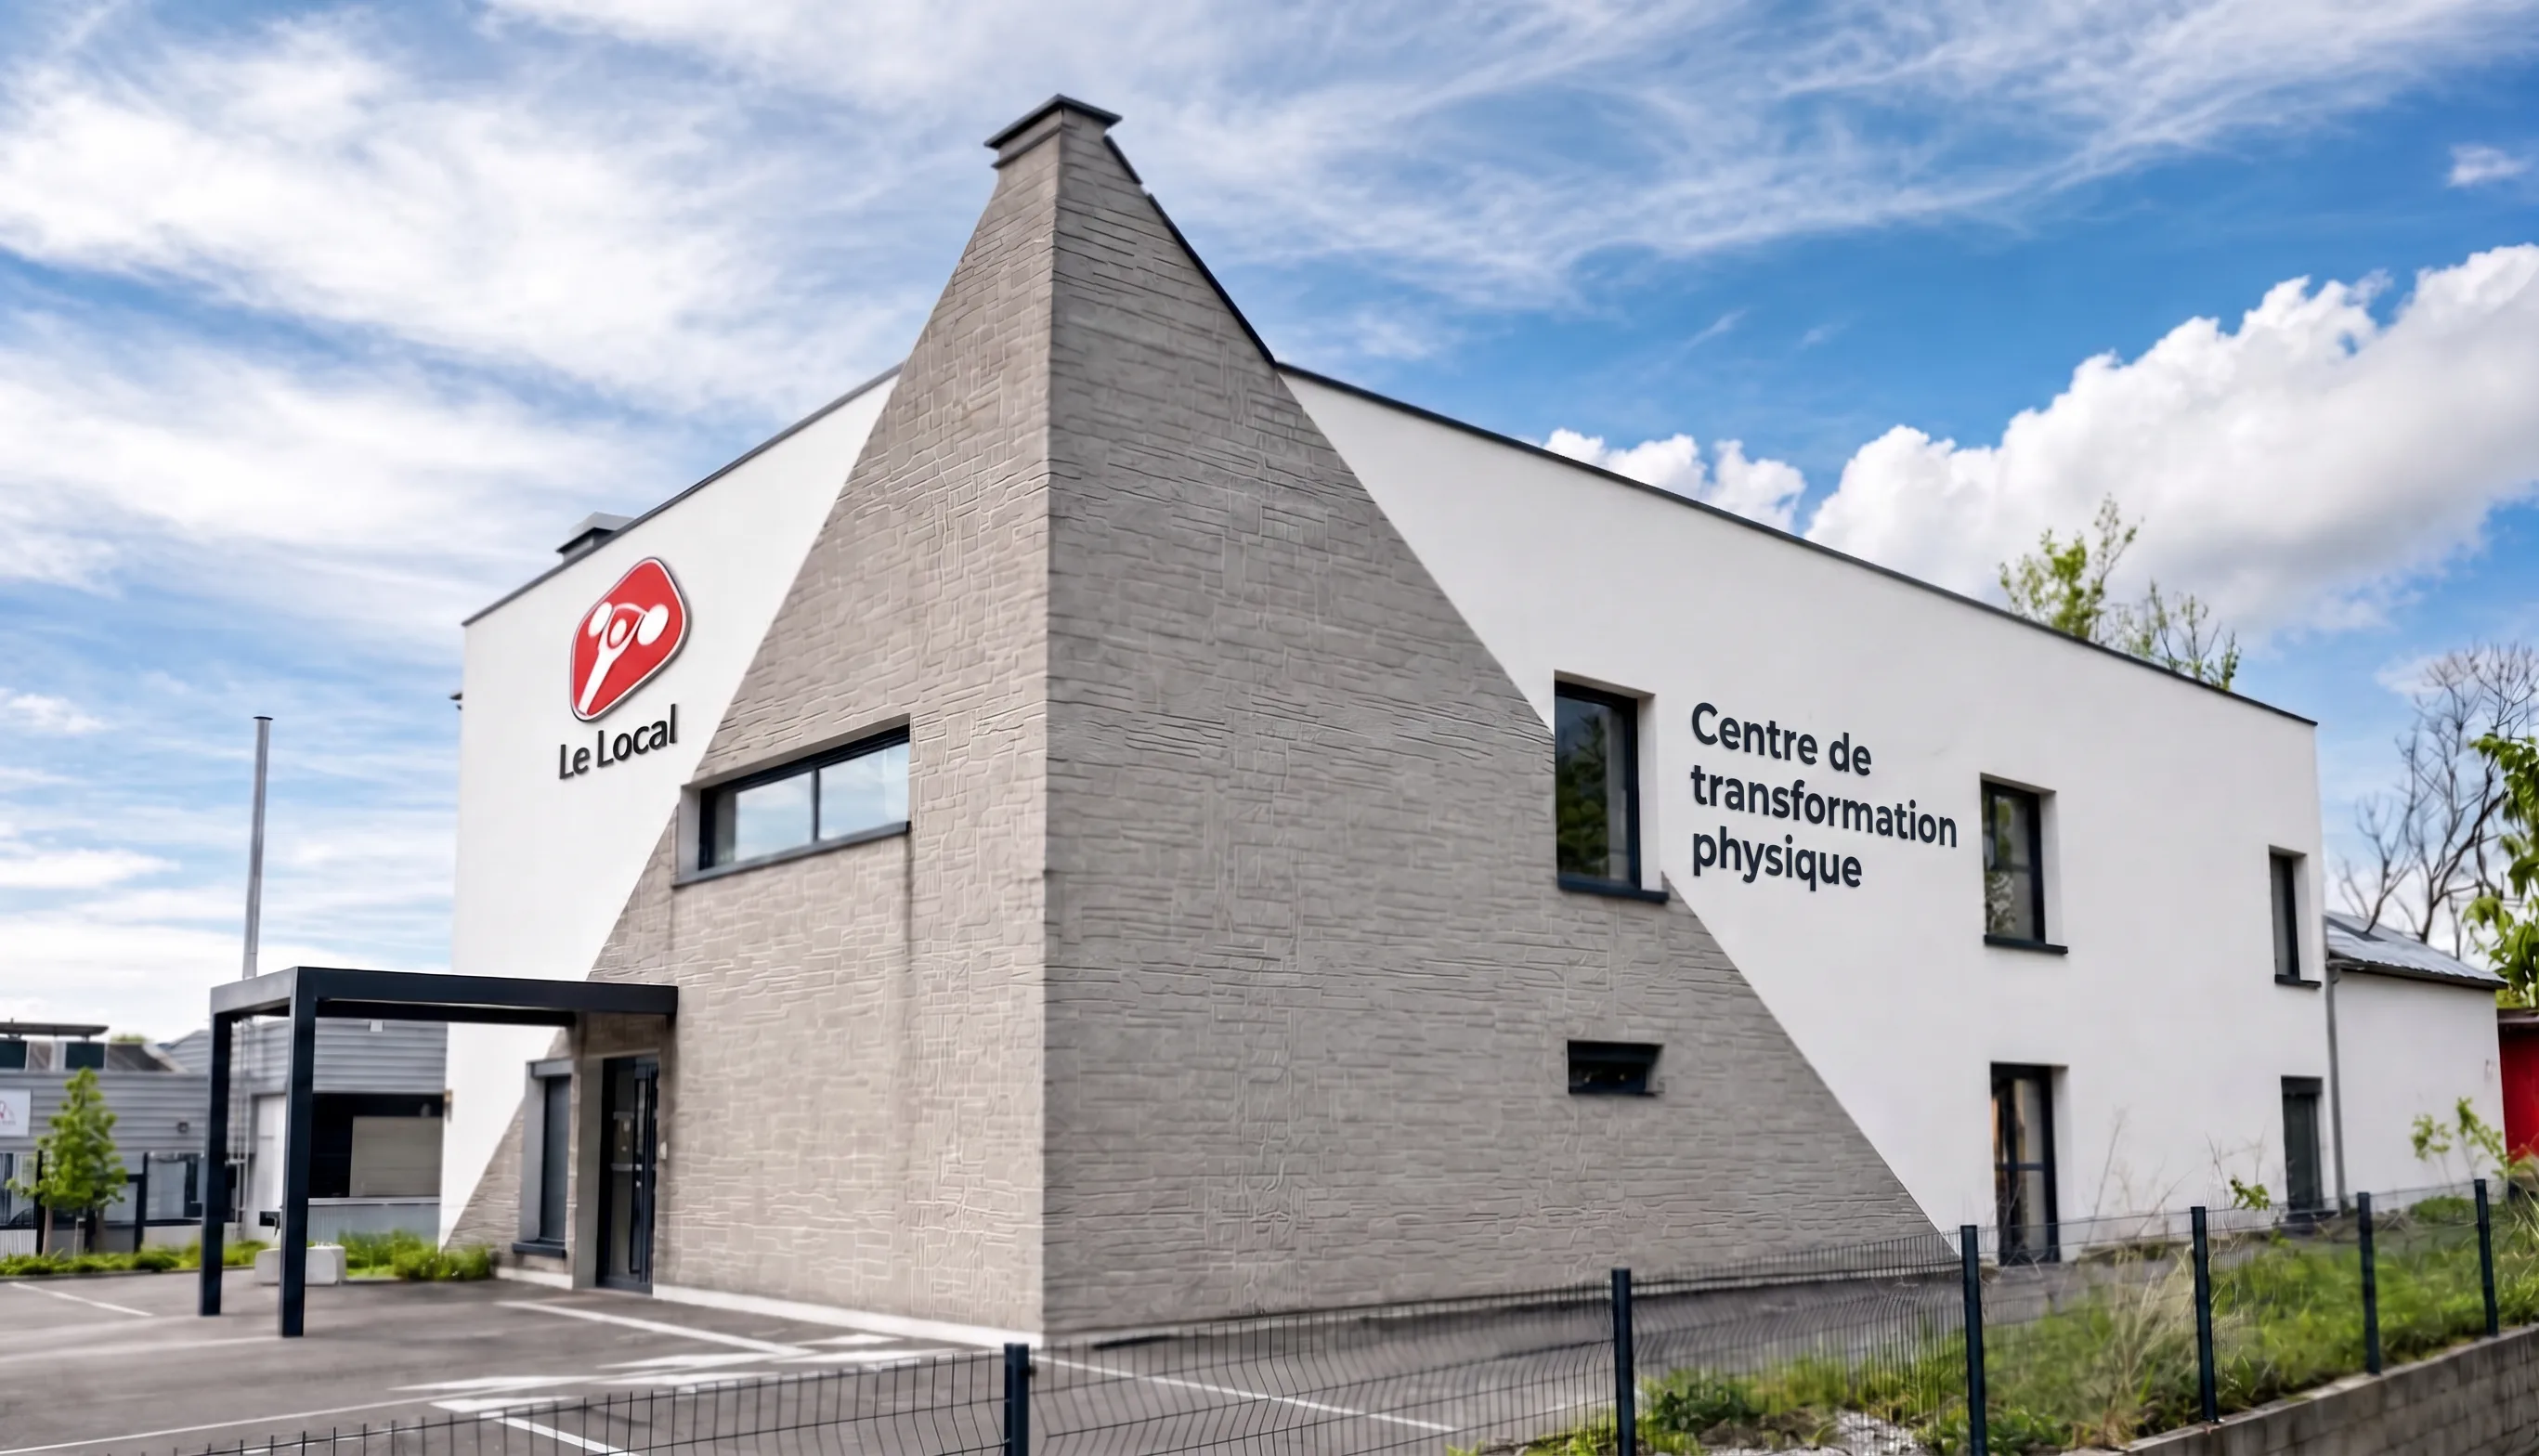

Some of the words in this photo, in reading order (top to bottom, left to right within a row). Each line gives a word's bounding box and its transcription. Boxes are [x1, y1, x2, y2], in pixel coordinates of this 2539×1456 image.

[558, 743, 591, 780] Le
[596, 703, 679, 768] Local
[1691, 702, 1818, 766] Centre
[1829, 732, 1872, 777] de
[1690, 764, 1958, 849] transformation
[1693, 825, 1863, 892] physique
